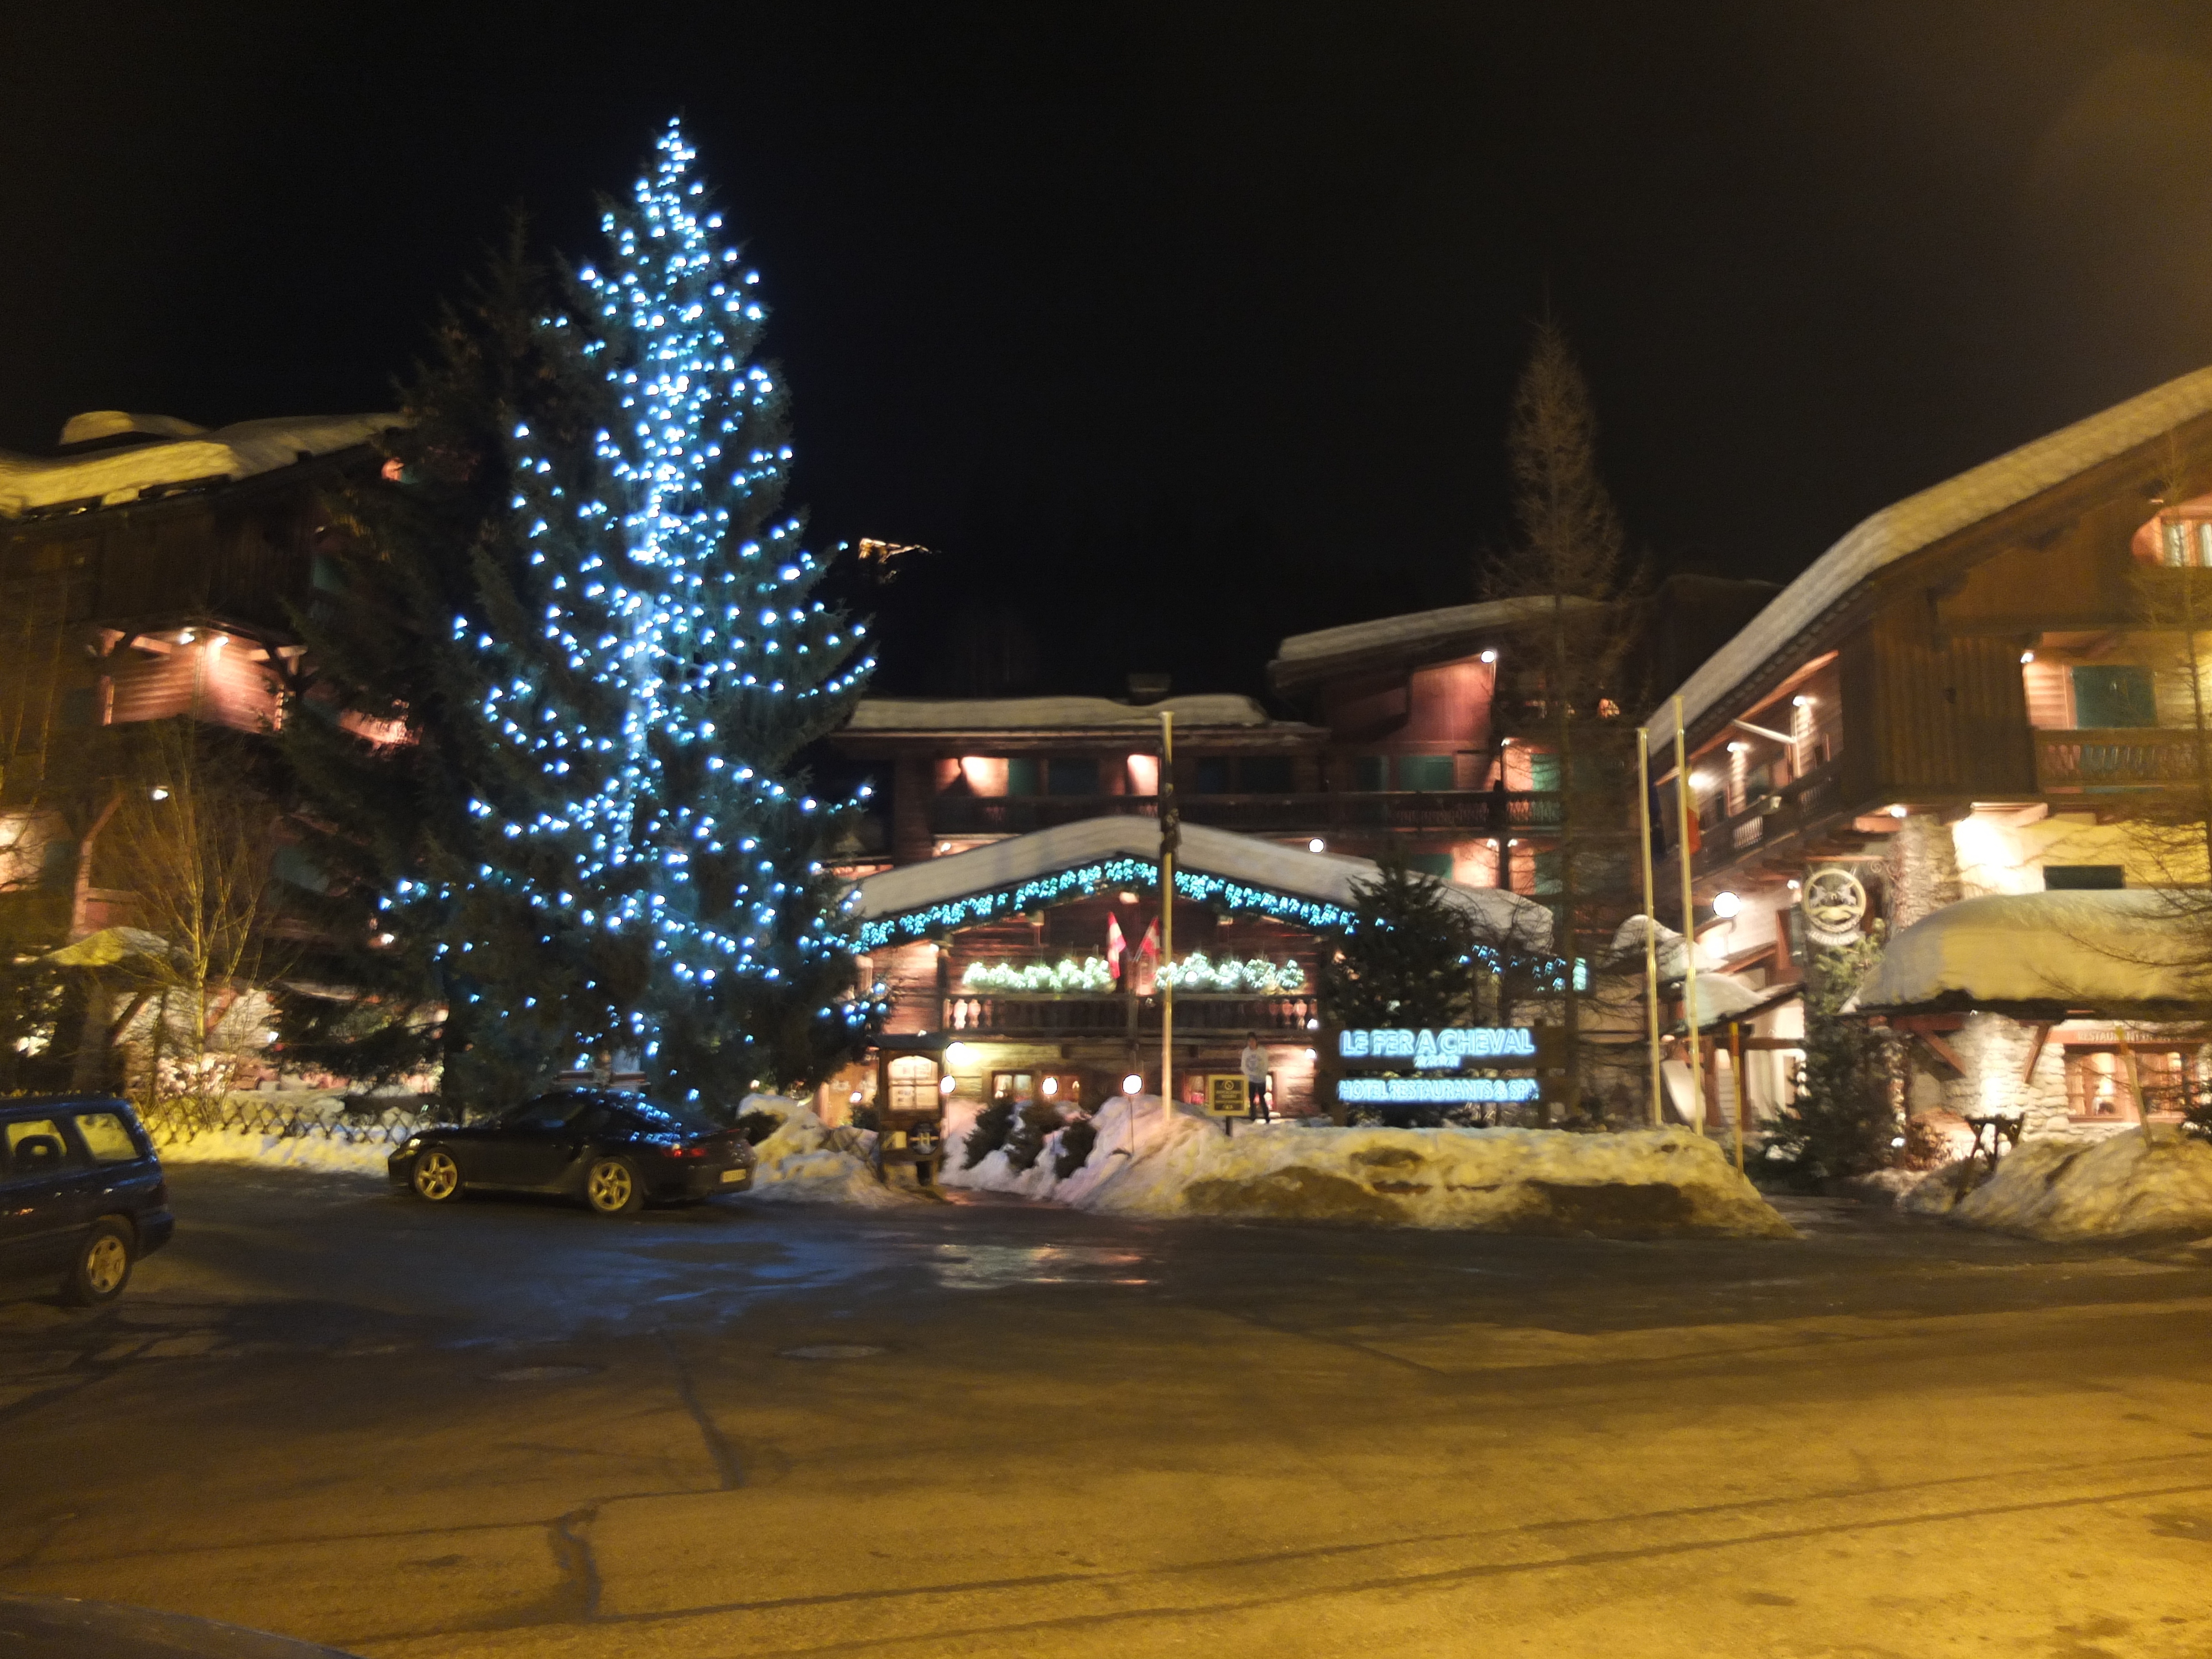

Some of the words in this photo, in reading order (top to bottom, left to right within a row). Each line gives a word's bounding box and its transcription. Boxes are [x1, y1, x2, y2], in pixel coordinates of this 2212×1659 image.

[1339, 1029, 1369, 1057] LE
[1370, 1029, 1415, 1056] FER
[1415, 1029, 1437, 1055] A
[1438, 1027, 1534, 1055] CHEVAL
[1337, 1079, 1389, 1101] HOTEL
[1388, 1079, 1493, 1101] RESTAURANTS
[1493, 1079, 1508, 1100] &
[1507, 1079, 1538, 1100] SPA
